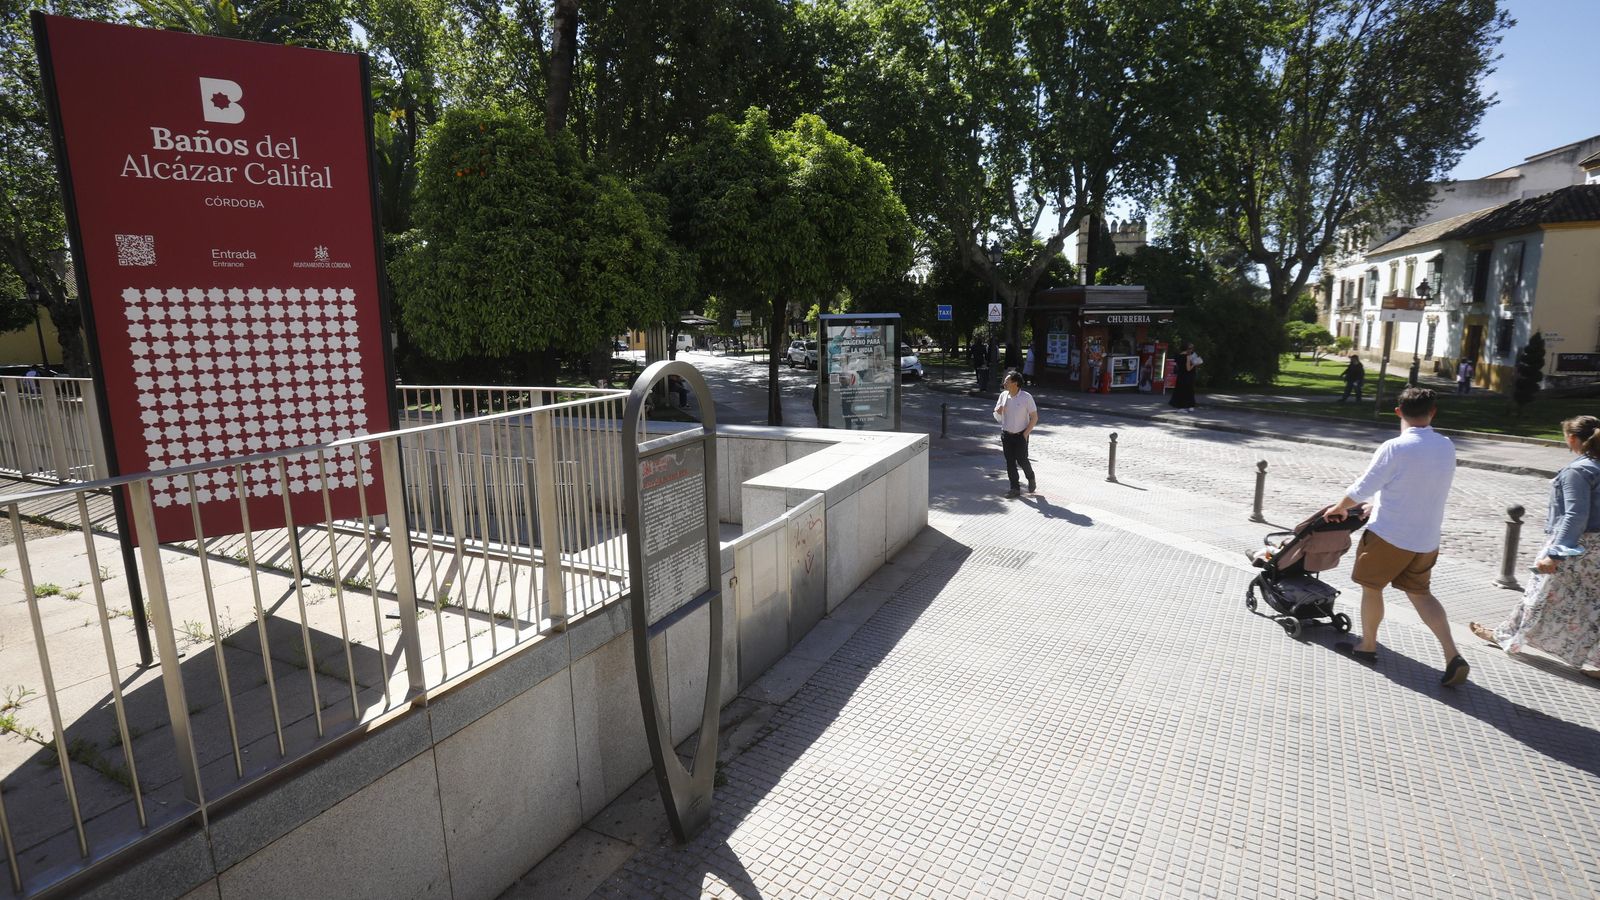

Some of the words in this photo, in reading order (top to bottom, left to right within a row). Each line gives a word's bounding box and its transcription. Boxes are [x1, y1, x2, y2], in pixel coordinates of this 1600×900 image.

[150, 126, 249, 156] Baños
[255, 135, 300, 160] del
[120, 154, 237, 184] Alcázar
[245, 163, 333, 189] Califal
[204, 195, 265, 208] CÓRDOBA
[211, 248, 257, 260] Entrada
[1107, 315, 1151, 323] CHURRERIA
